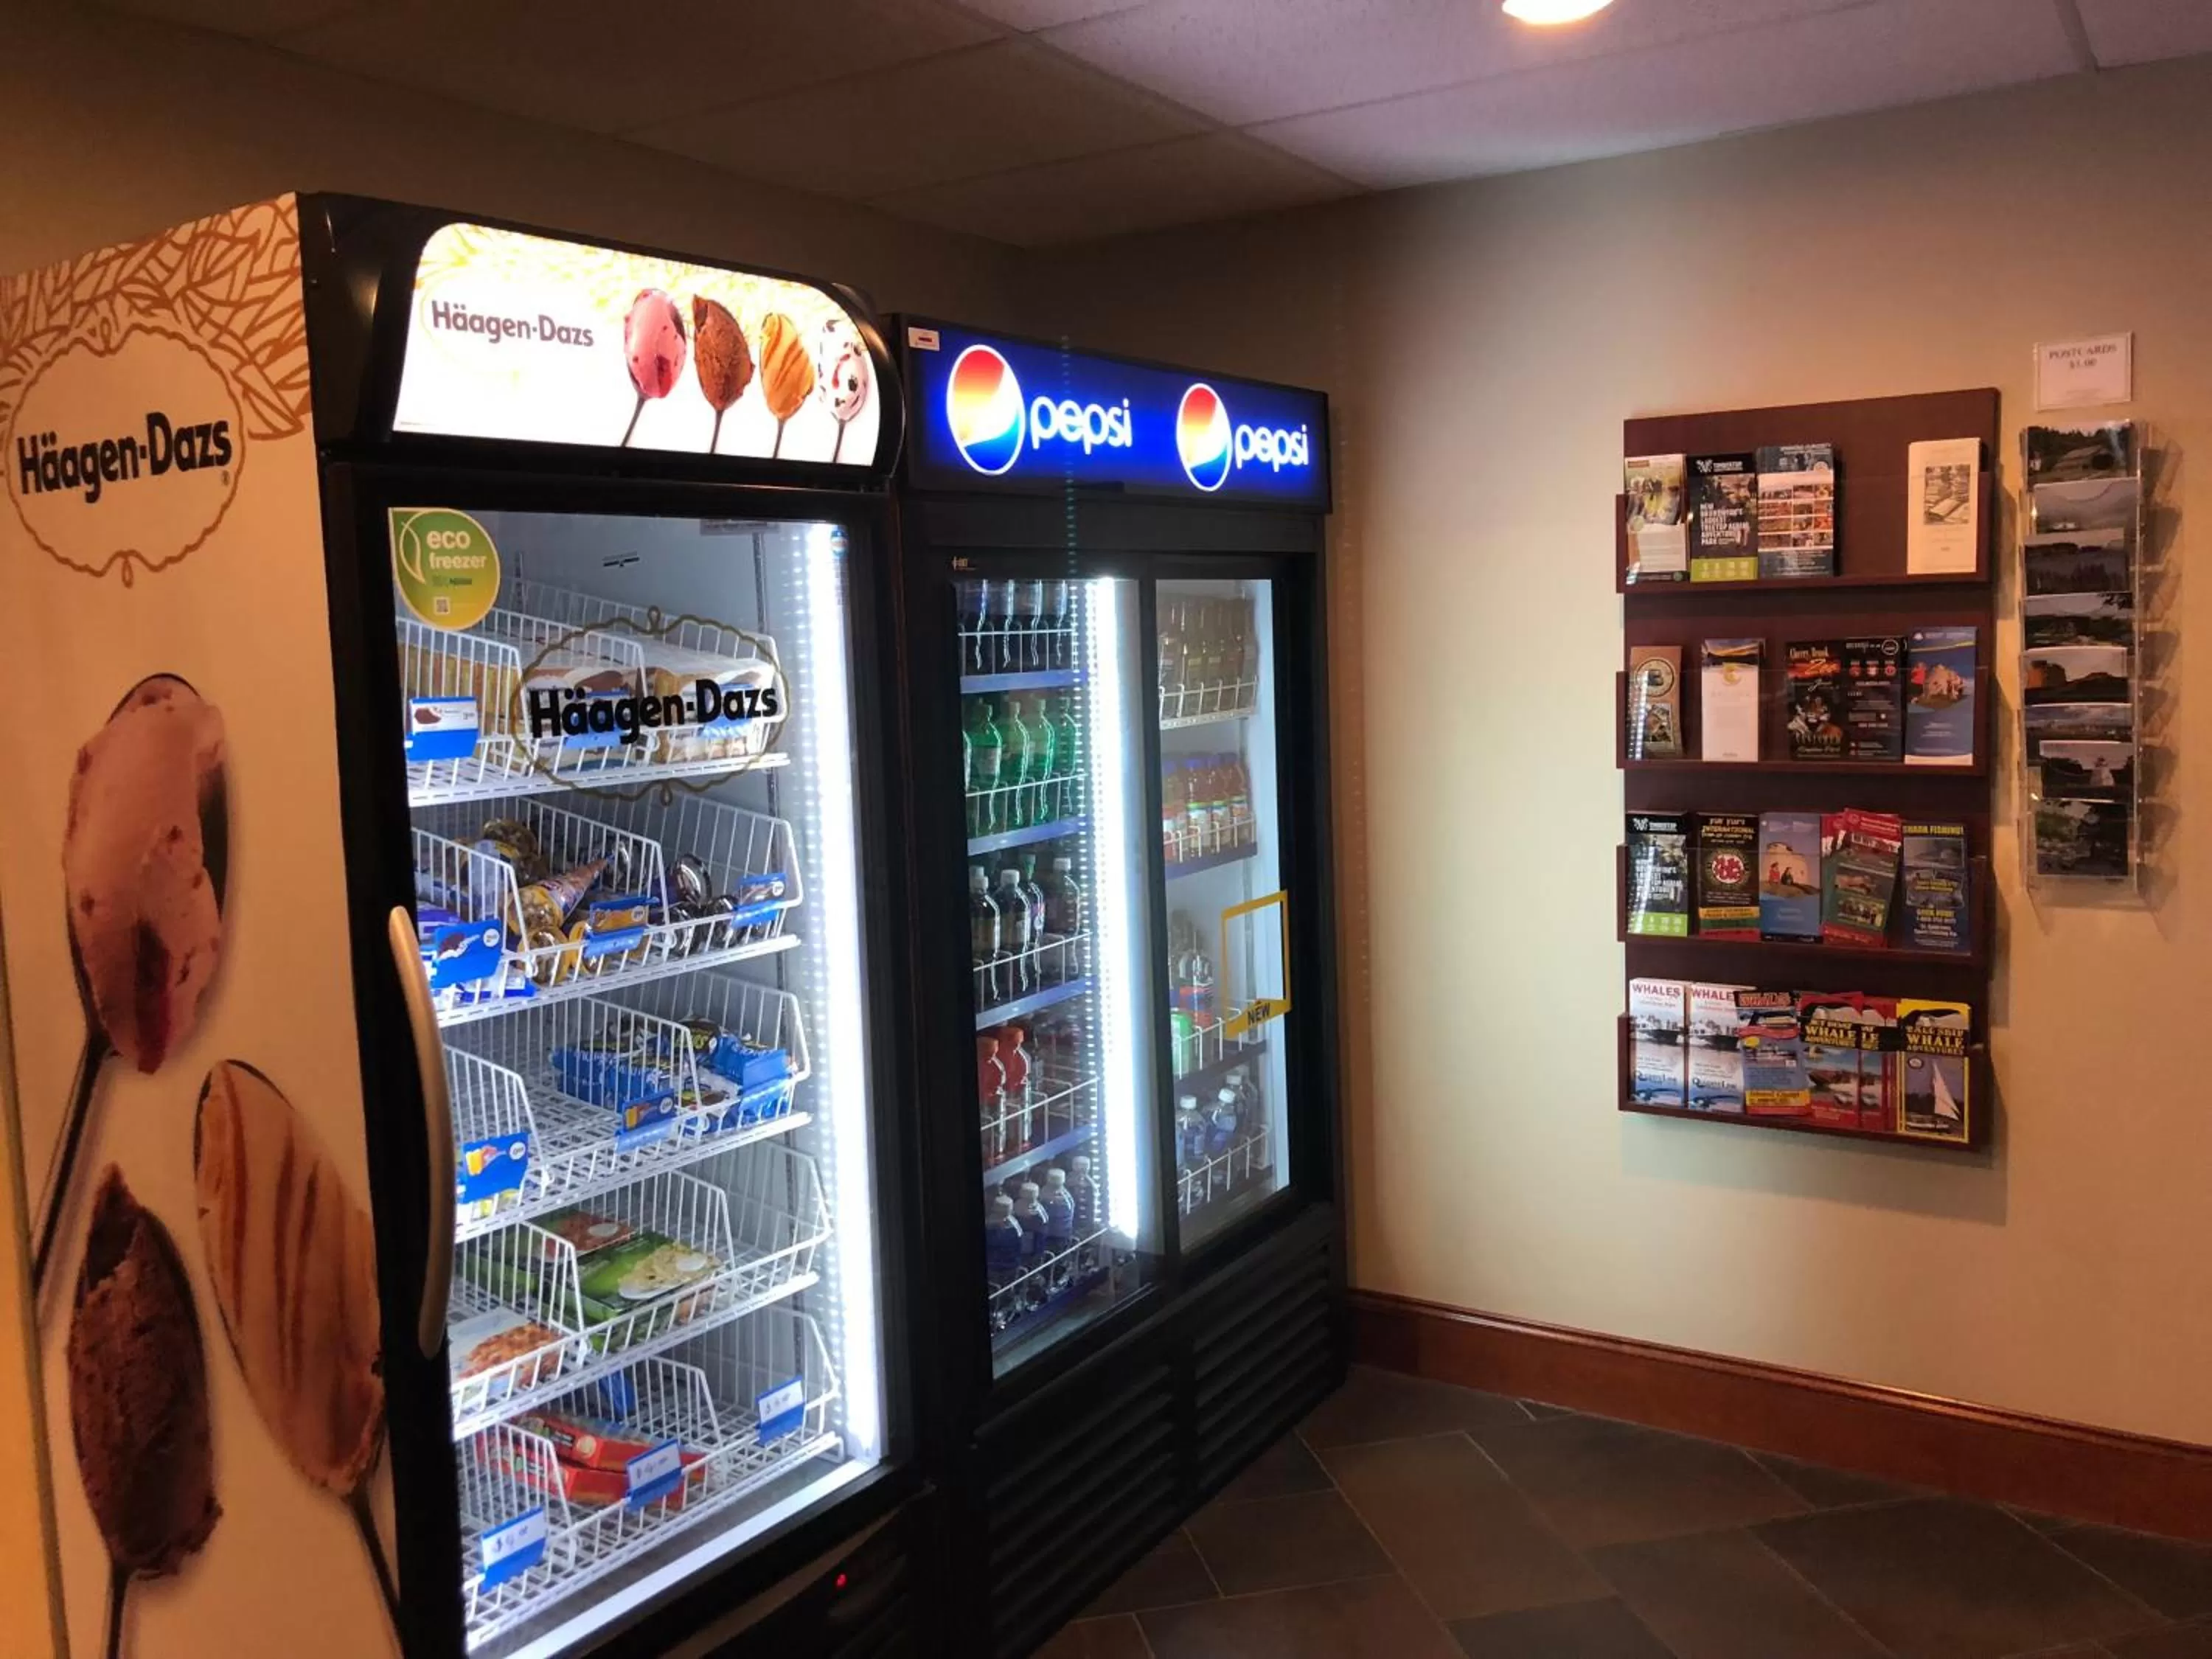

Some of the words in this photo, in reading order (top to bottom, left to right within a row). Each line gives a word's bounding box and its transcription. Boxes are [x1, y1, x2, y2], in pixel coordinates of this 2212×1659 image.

[1030, 397, 1132, 455] pepsi
[1236, 425, 1309, 472] pepsi
[426, 530, 471, 549] eco
[429, 552, 487, 570] freezer
[1632, 984, 1680, 997] WHALES
[1691, 988, 1735, 1001] WHALE
[1248, 1003, 1270, 1025] NEW
[1806, 1026, 1857, 1040] WHALE
[1905, 1033, 1964, 1048] WHALE
